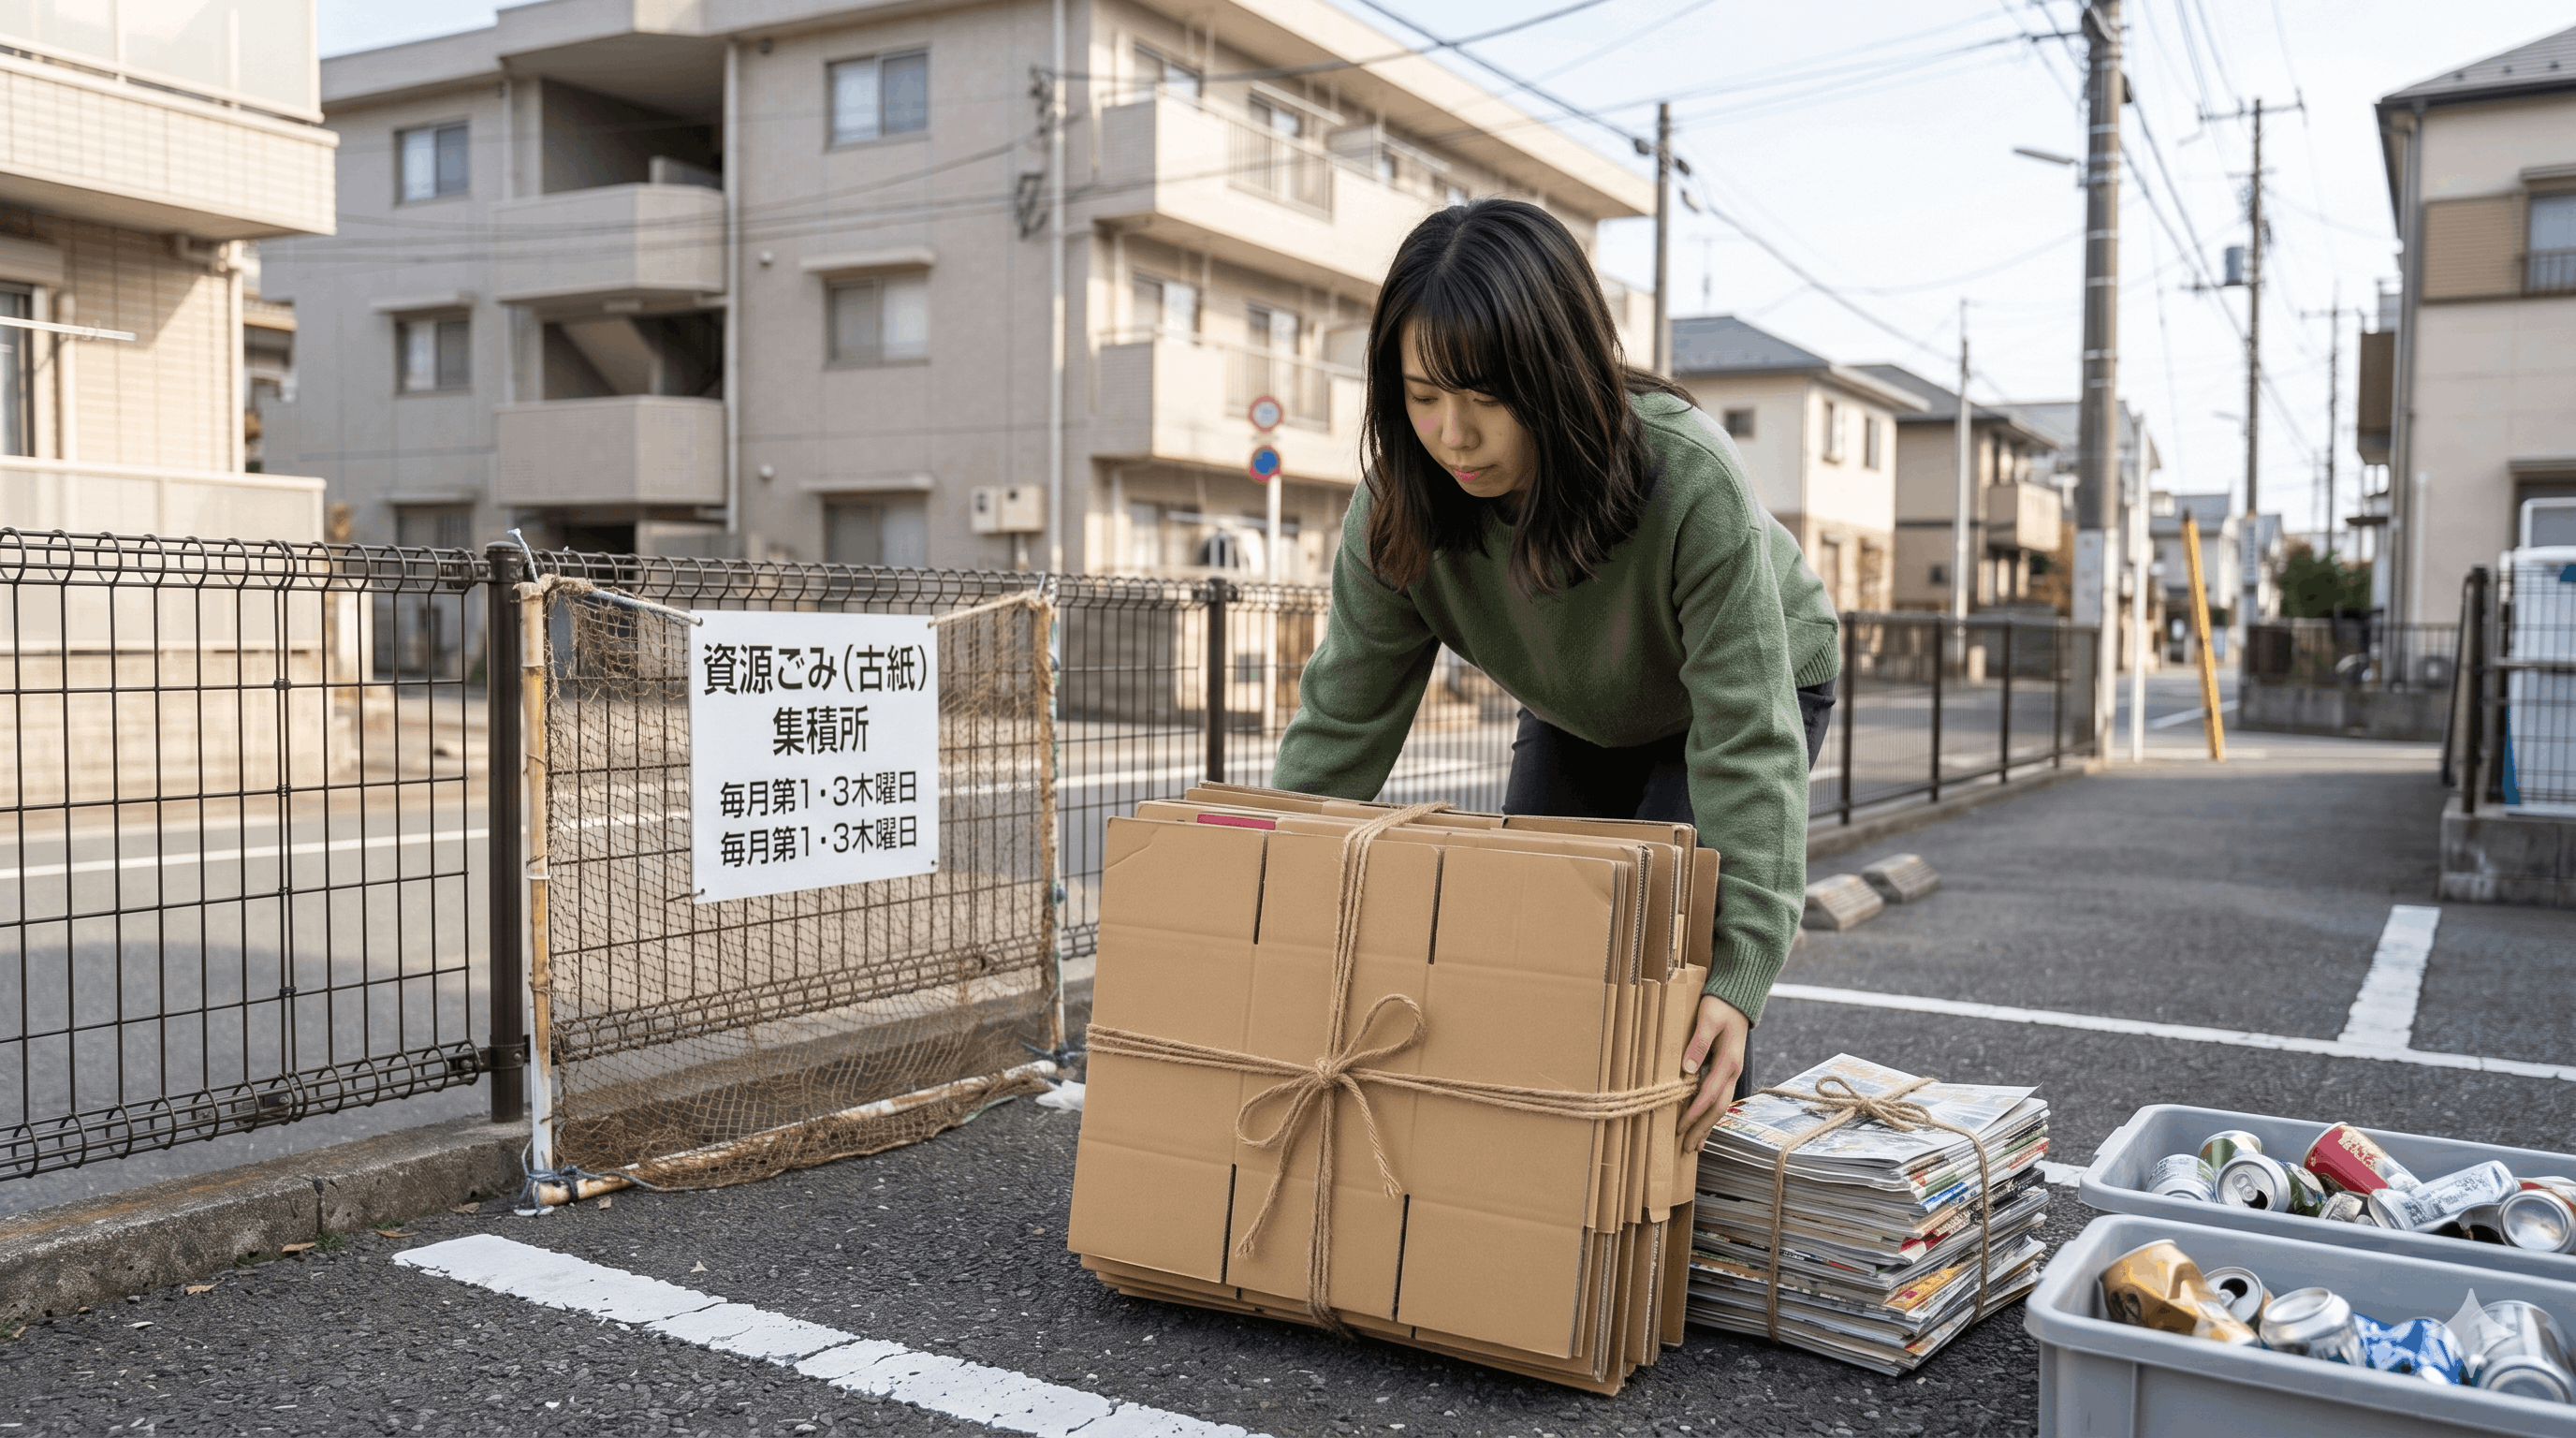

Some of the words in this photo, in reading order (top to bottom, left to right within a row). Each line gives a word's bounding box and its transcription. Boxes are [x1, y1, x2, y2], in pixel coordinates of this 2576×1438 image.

[703, 642, 927, 696] 資源ごみ（古紙）
[772, 705, 869, 756] 集積所
[720, 770, 916, 819] 毎月第1・3木曜日
[720, 815, 916, 868] 毎月第1・3木曜日
